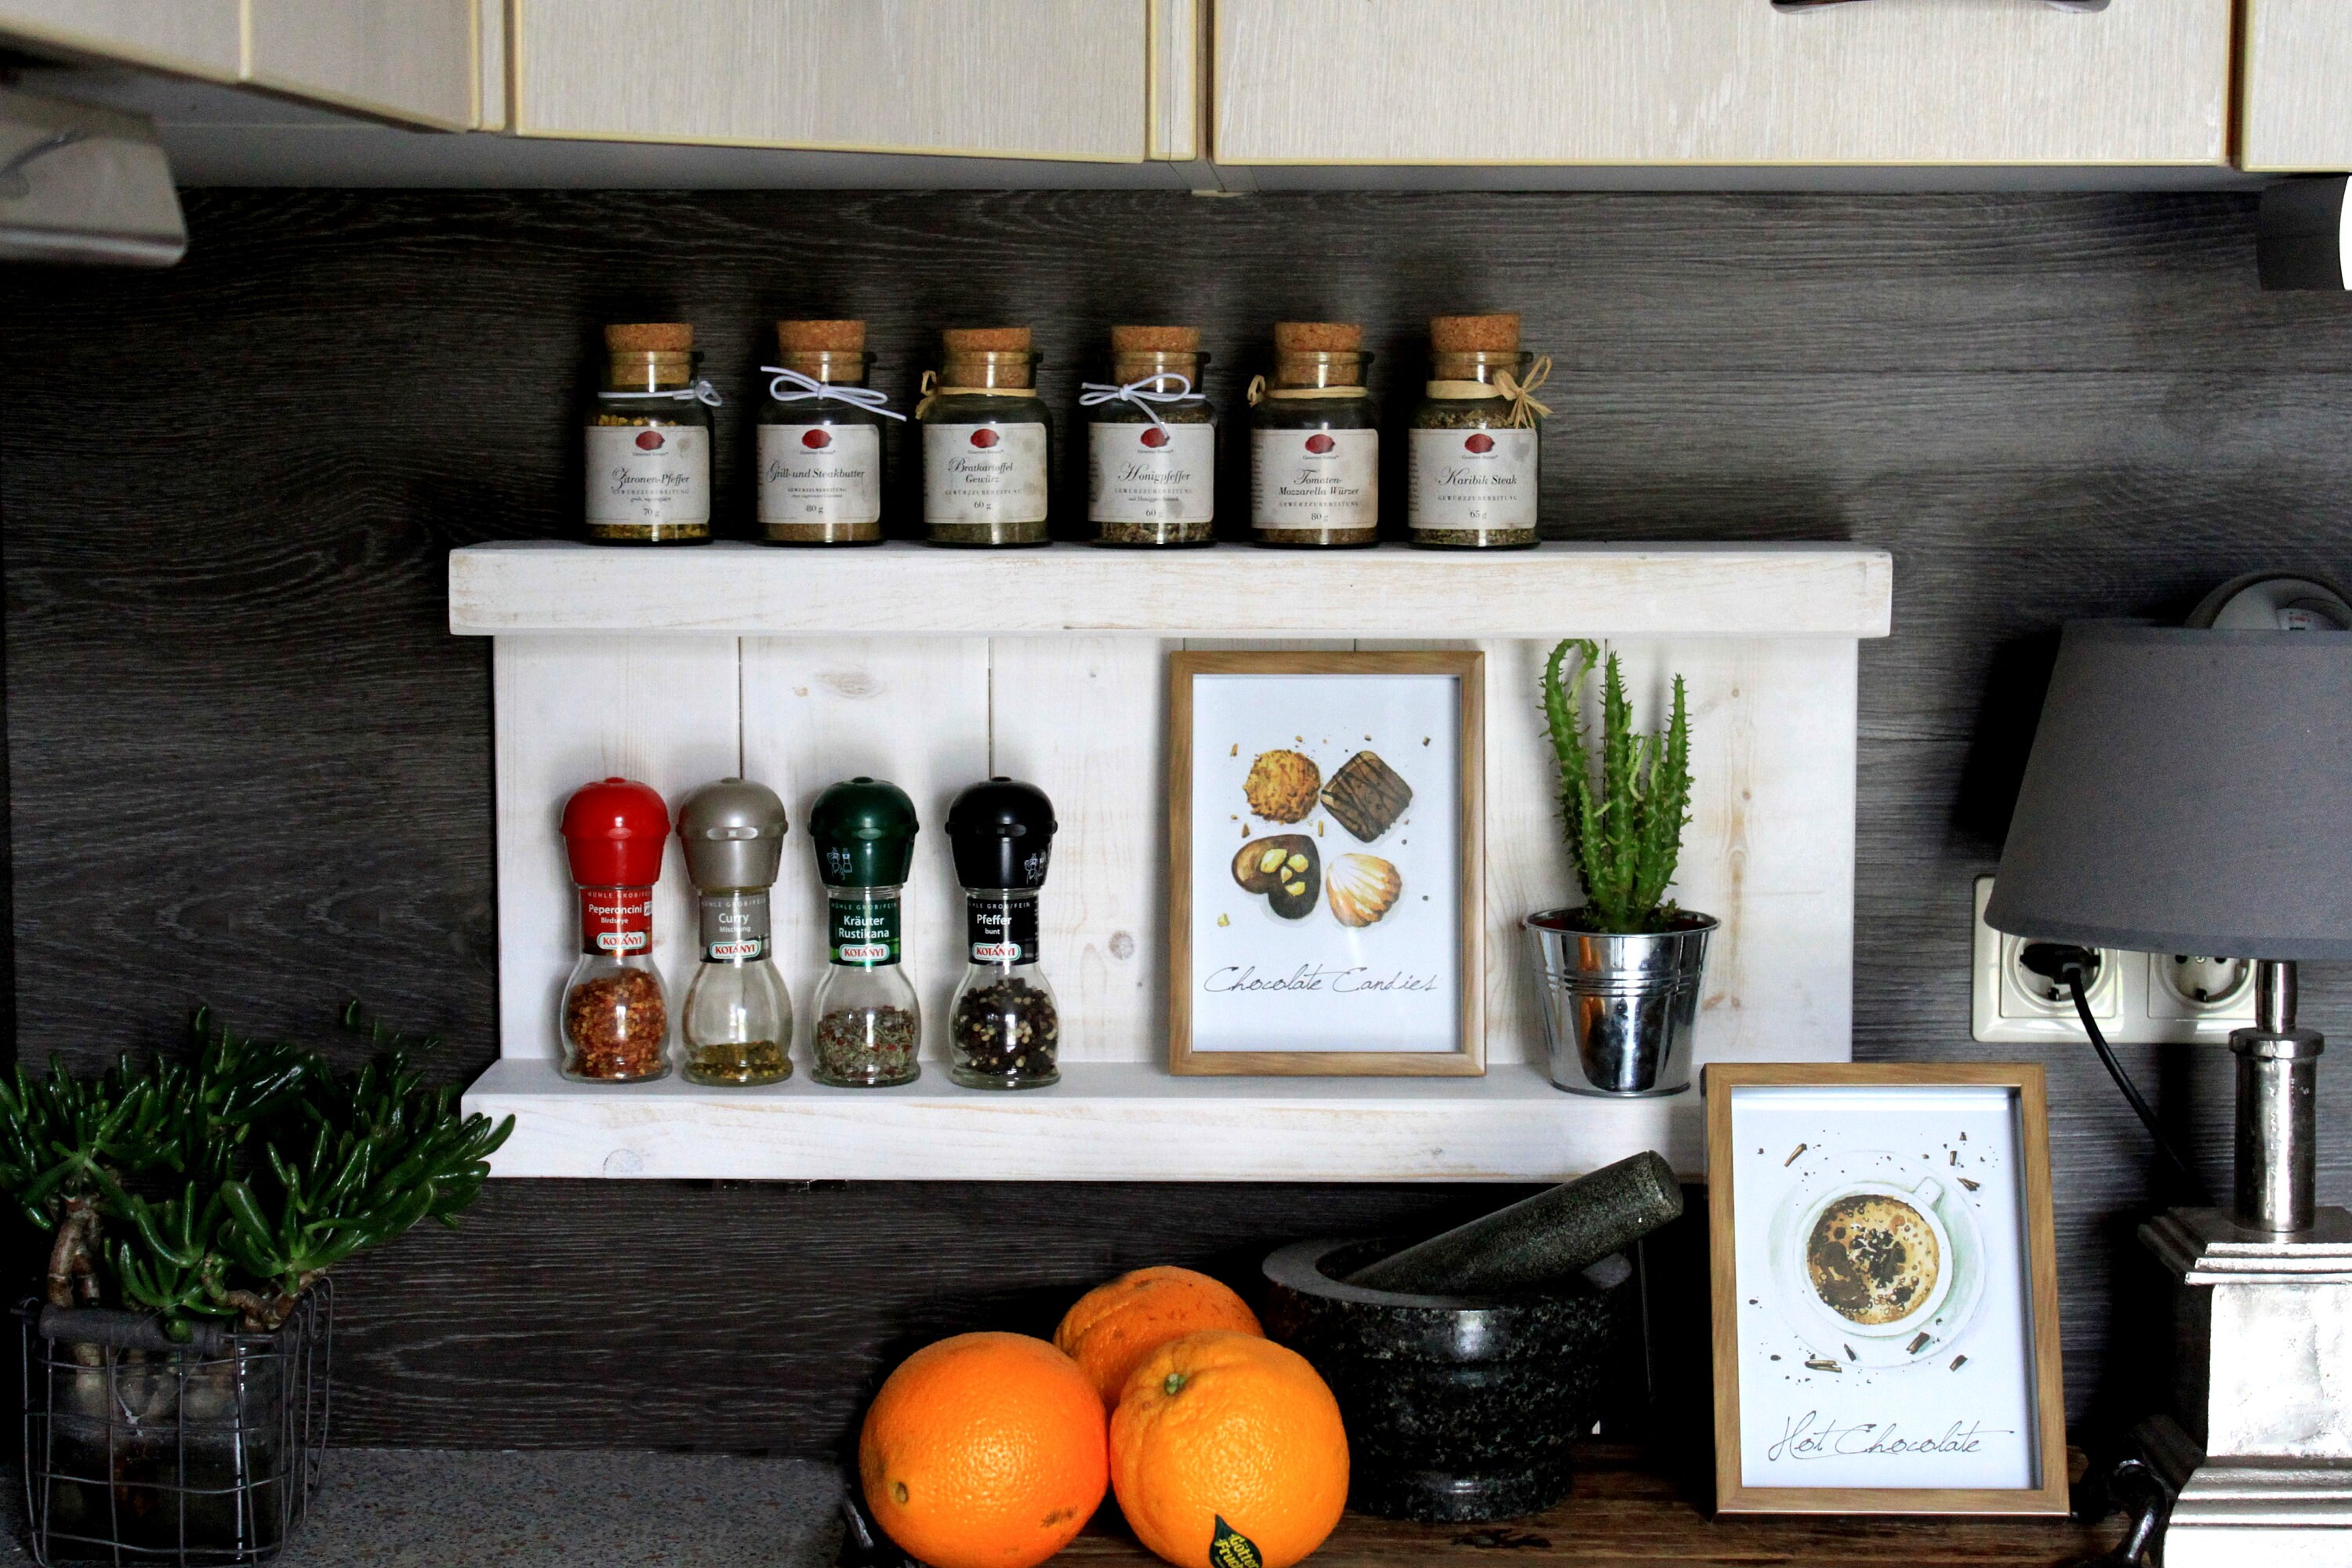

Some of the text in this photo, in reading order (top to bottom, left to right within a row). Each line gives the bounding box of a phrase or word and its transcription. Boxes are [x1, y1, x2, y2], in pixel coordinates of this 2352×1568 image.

[948, 456, 1014, 474] Bratkartoffel
[767, 459, 865, 483] Grill- und Steakbutter
[1118, 461, 1191, 485] Honigpfeffer
[1438, 466, 1518, 487] Karibik Steak
[611, 467, 690, 490] Zitronen-Pfeffer
[965, 474, 1000, 484] Gewürz
[1294, 469, 1342, 485] Tomaten-
[1279, 486, 1327, 495] Mozzarella
[1470, 510, 1480, 518] 65
[589, 904, 643, 915] Peperoncini
[718, 913, 750, 924] Curry
[844, 916, 884, 926] Kräuter
[977, 914, 1012, 925] Pfeffer
[839, 927, 889, 938] Rustikana
[603, 933, 642, 946] KOTÁNYI
[715, 942, 755, 954] KOTÁNYI
[844, 946, 884, 956] KOTÁNYI
[976, 945, 1015, 956] KOTÁNYI
[1204, 964, 1437, 993] Chocolate Candies
[1768, 1410, 2015, 1461] Hot Chocolate
